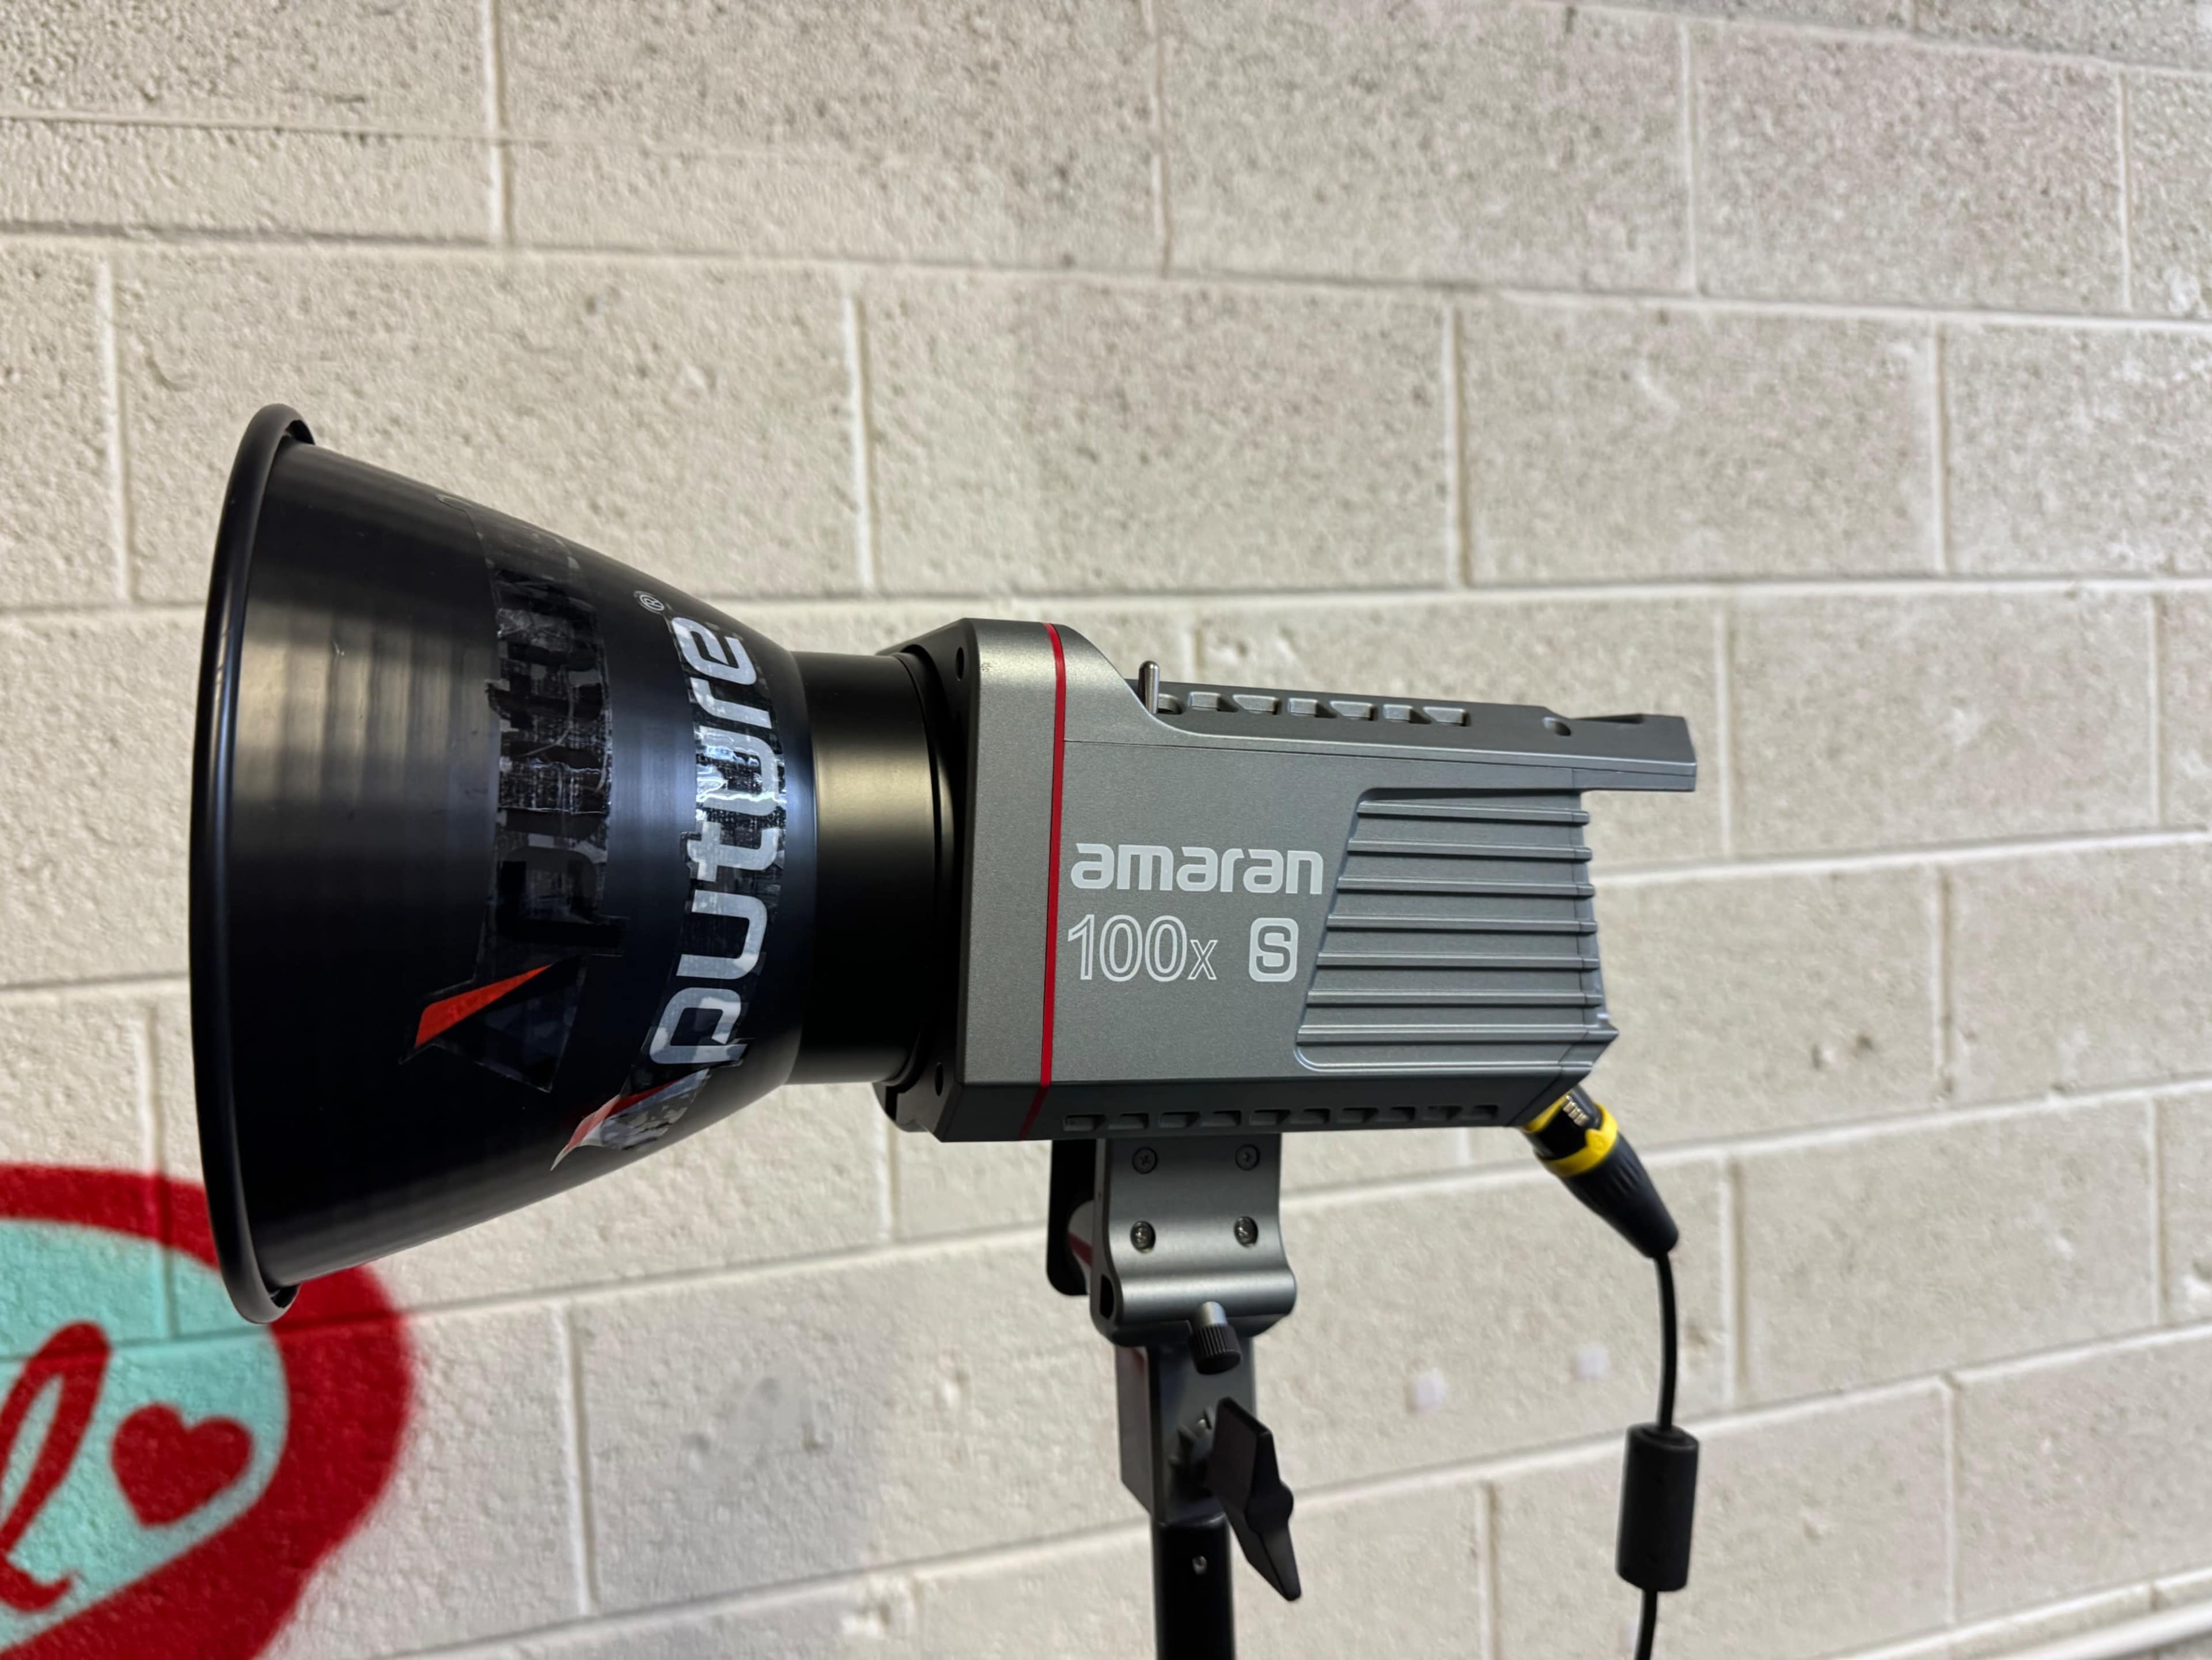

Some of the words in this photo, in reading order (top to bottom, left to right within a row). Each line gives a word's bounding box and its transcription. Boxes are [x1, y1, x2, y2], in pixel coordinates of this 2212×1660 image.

[1070, 842, 1324, 895] amaran
[1067, 914, 1218, 982] 100x
[1255, 924, 1293, 976] S
